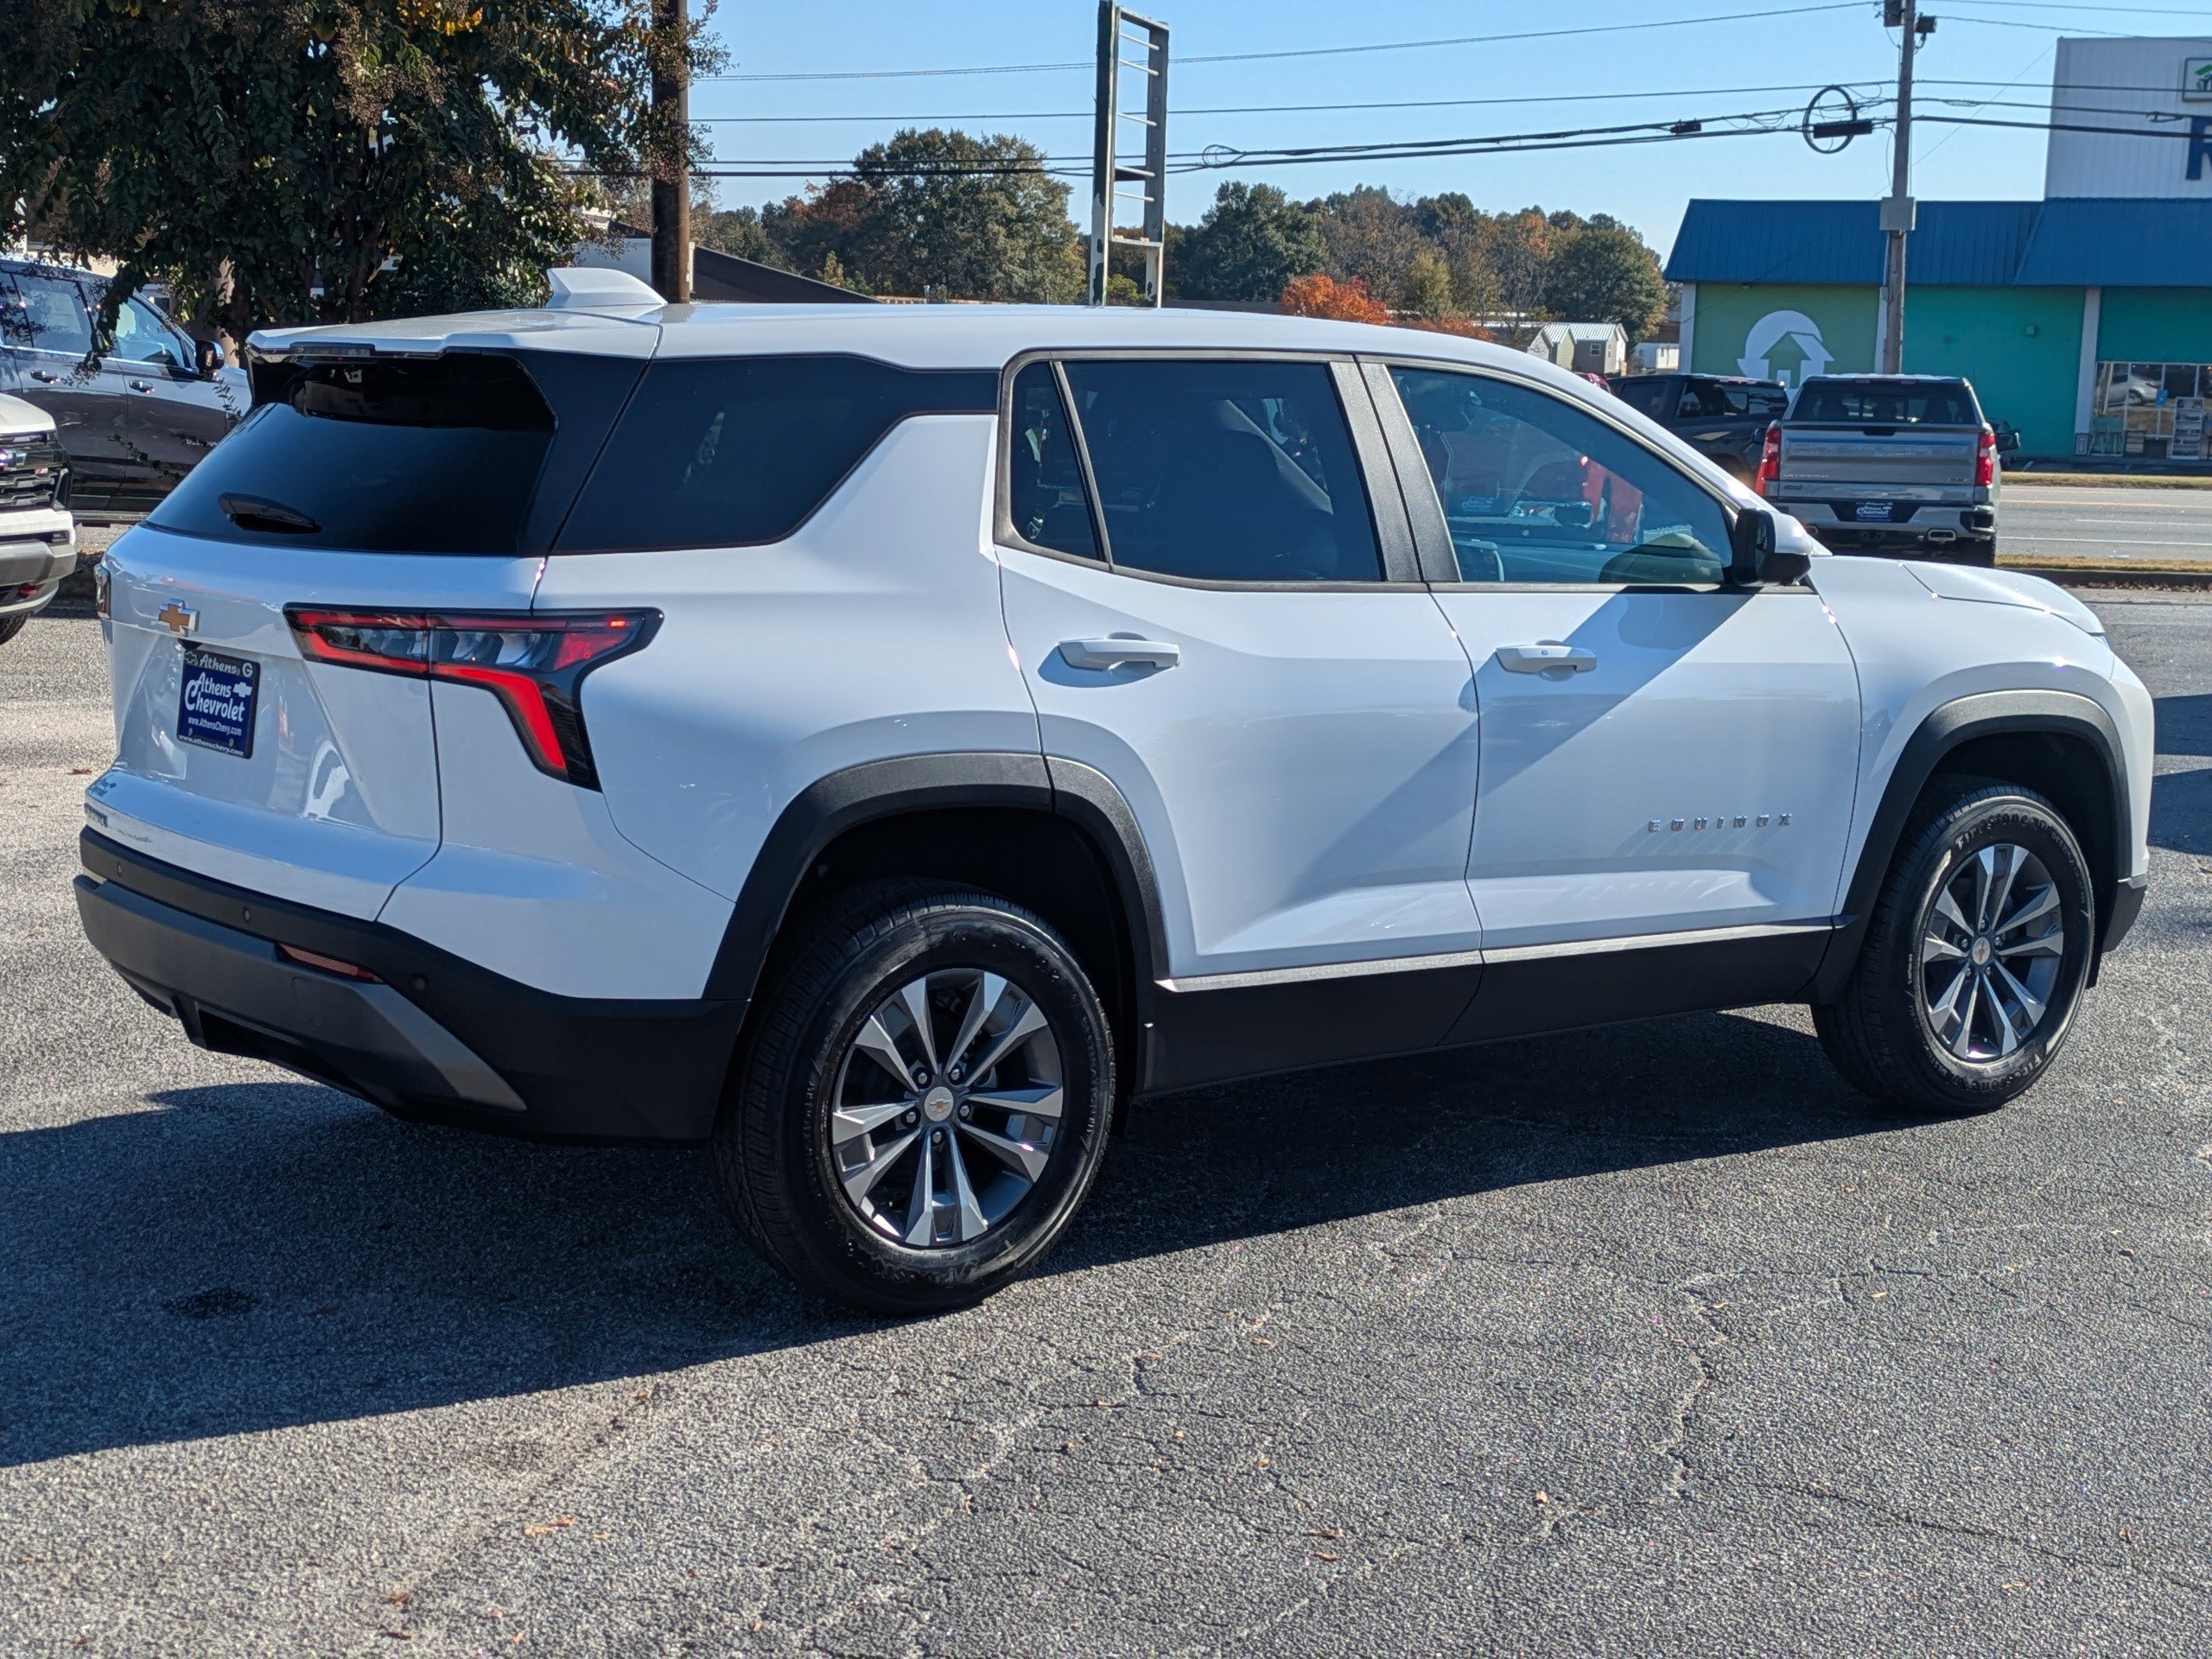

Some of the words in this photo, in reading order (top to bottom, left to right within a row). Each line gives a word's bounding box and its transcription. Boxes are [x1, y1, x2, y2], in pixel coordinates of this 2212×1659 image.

[200, 653, 238, 674] Athens
[196, 671, 232, 698] Athens
[184, 679, 245, 722] Chevrolet
[1648, 812, 1793, 833] EQUINOX
